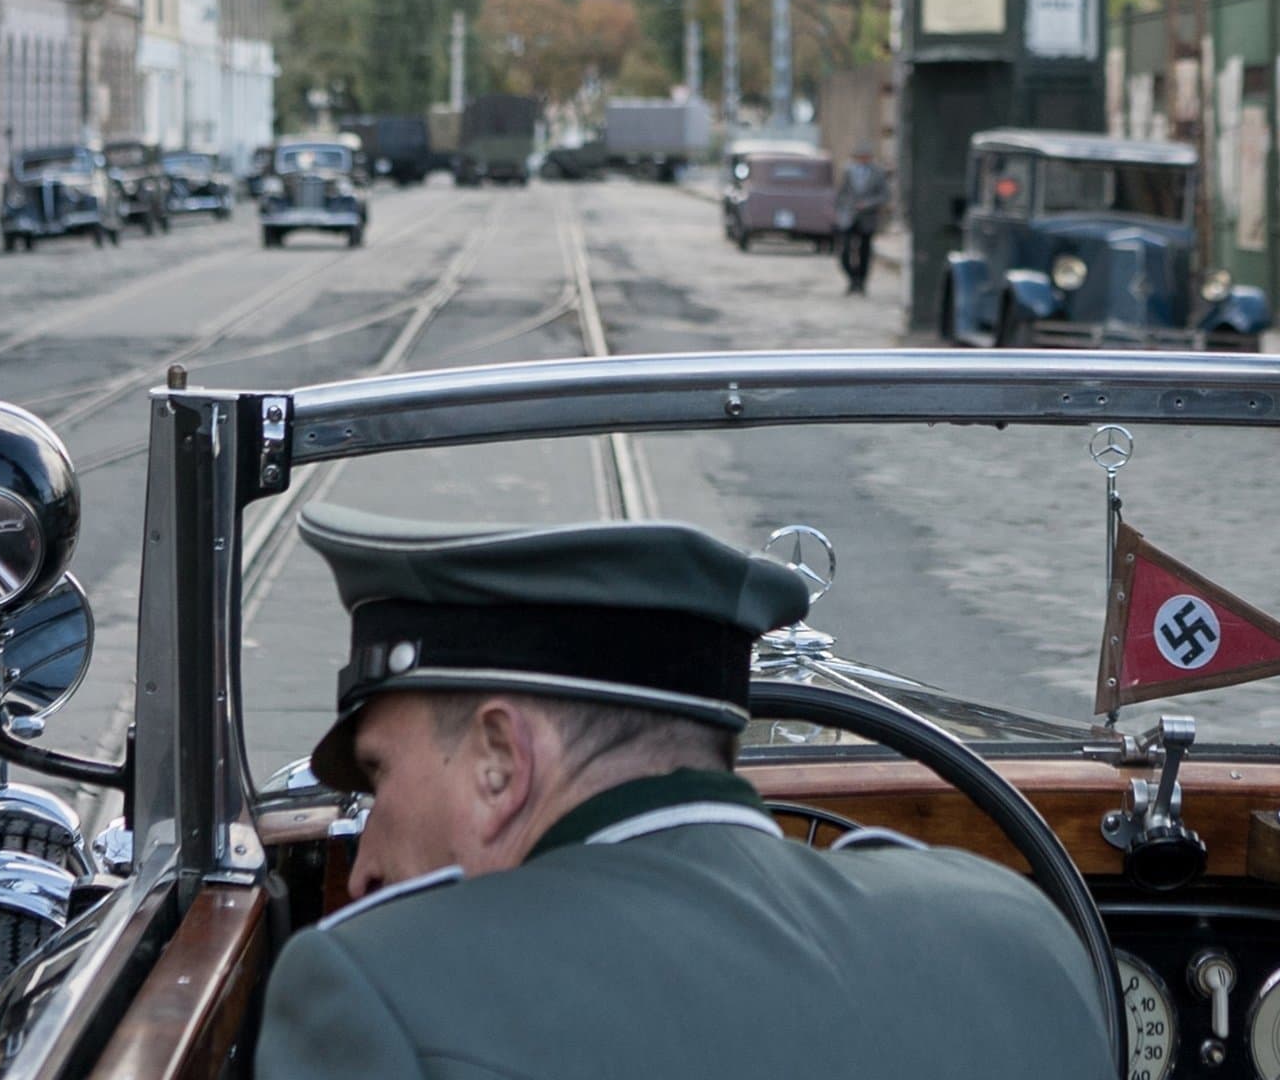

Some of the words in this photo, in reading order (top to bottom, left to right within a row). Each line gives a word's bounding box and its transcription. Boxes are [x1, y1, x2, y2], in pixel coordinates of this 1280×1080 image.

[1141, 997, 1156, 1012] 10
[1146, 1021, 1165, 1036] 20
[1144, 1045, 1163, 1060] 30
